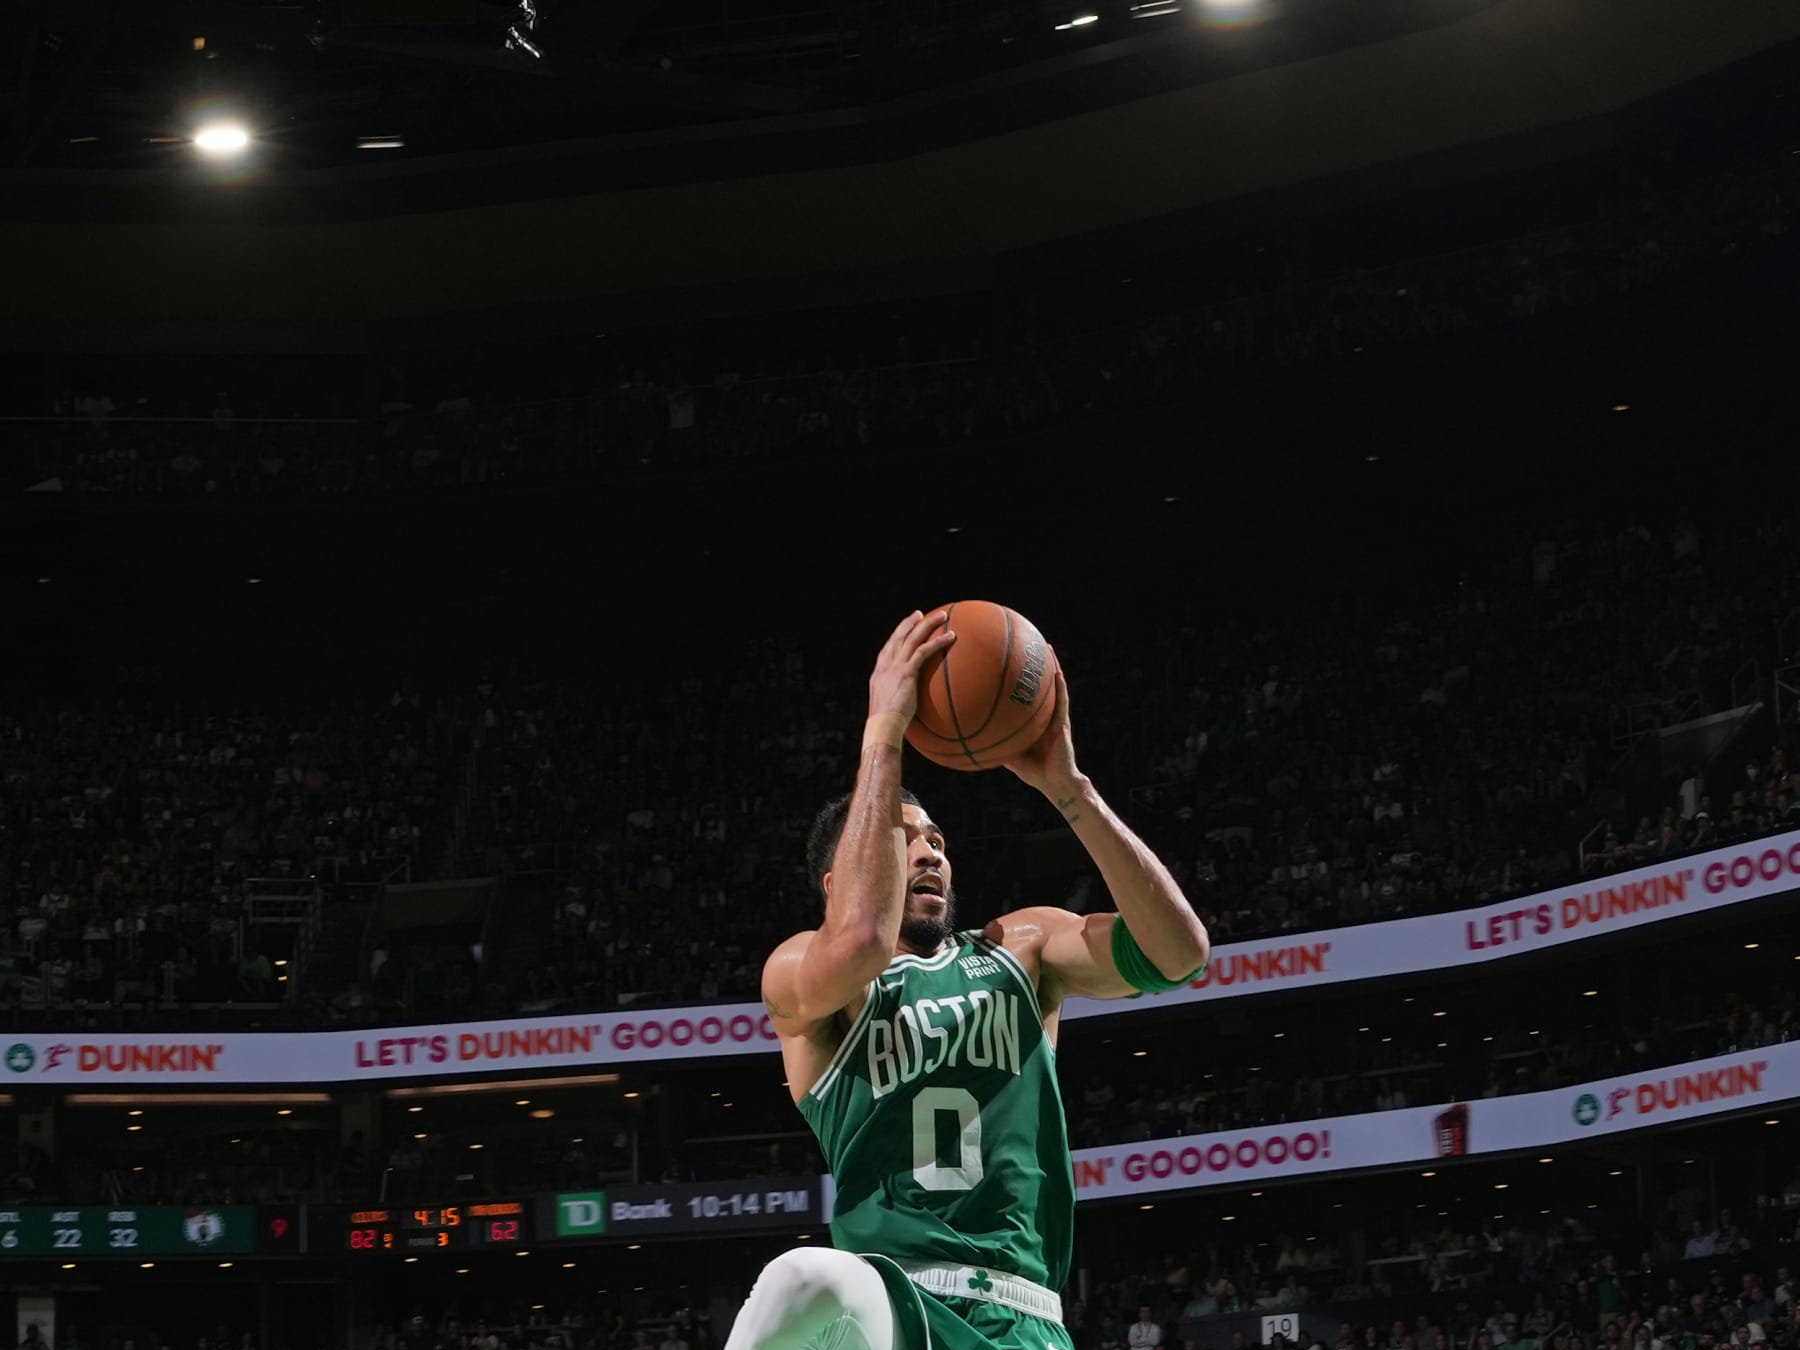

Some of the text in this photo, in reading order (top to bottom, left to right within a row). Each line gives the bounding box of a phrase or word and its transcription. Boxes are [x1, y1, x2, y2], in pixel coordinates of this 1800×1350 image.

[1465, 903, 1553, 950] LET'S
[1560, 868, 1694, 928] DUNKIN'
[957, 954, 999, 971] VISTA
[966, 962, 1001, 980] PRINT
[76, 1043, 225, 1072] DUNKIN'
[356, 1035, 448, 1068] LET'S
[457, 1025, 602, 1060] DUNKIN'
[867, 989, 1020, 1100] BOSTON
[1636, 1060, 1768, 1114] DUNKIN'
[912, 1086, 984, 1190] 0
[1121, 1129, 1331, 1183] GOOOOOO!
[561, 1190, 808, 1226] TD Bank 10:14 PM
[1, 1229, 138, 1248] 6 22 32
[350, 1229, 377, 1248] 82
[437, 1232, 449, 1247] 3
[490, 1221, 518, 1241] 62
